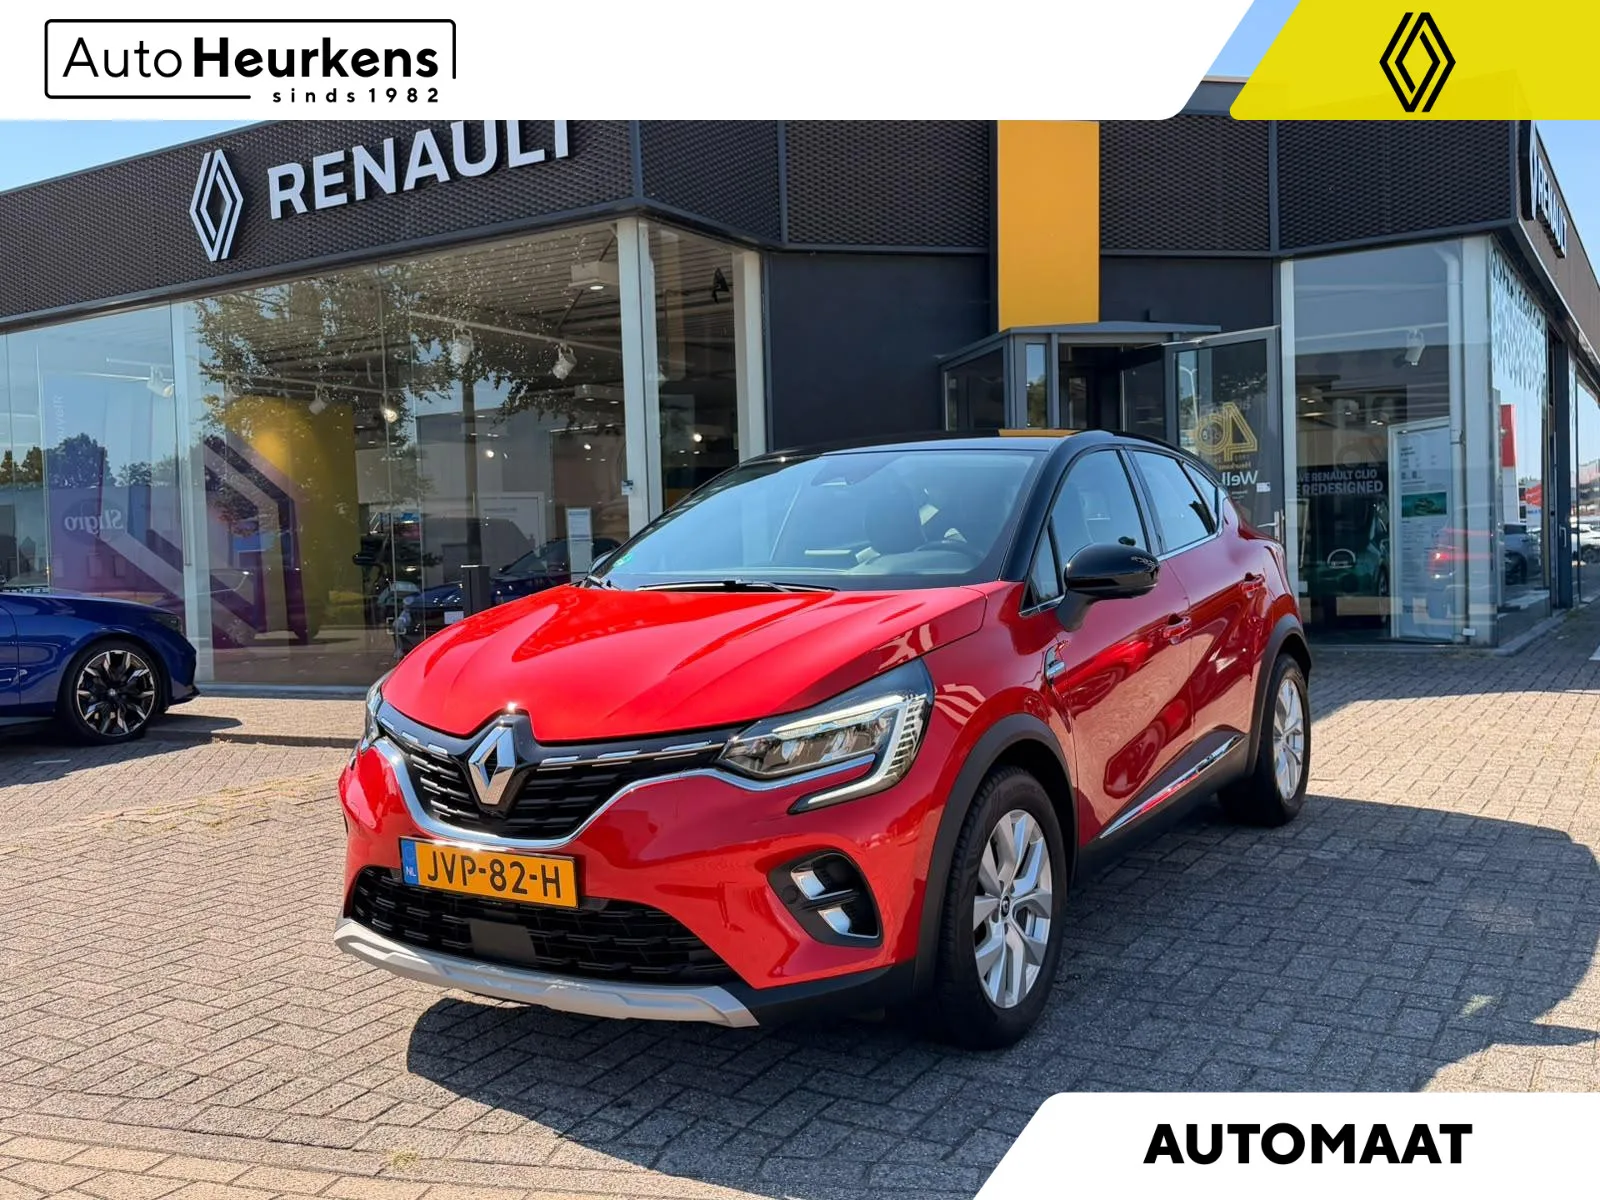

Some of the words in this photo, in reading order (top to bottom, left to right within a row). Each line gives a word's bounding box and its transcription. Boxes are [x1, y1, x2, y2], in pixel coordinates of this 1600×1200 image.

[1311, 470, 1354, 481] RENAULT
[1354, 468, 1377, 479] CLIO
[1302, 480, 1384, 496] REDESIGNED
[427, 851, 561, 898] JVP-82-H
